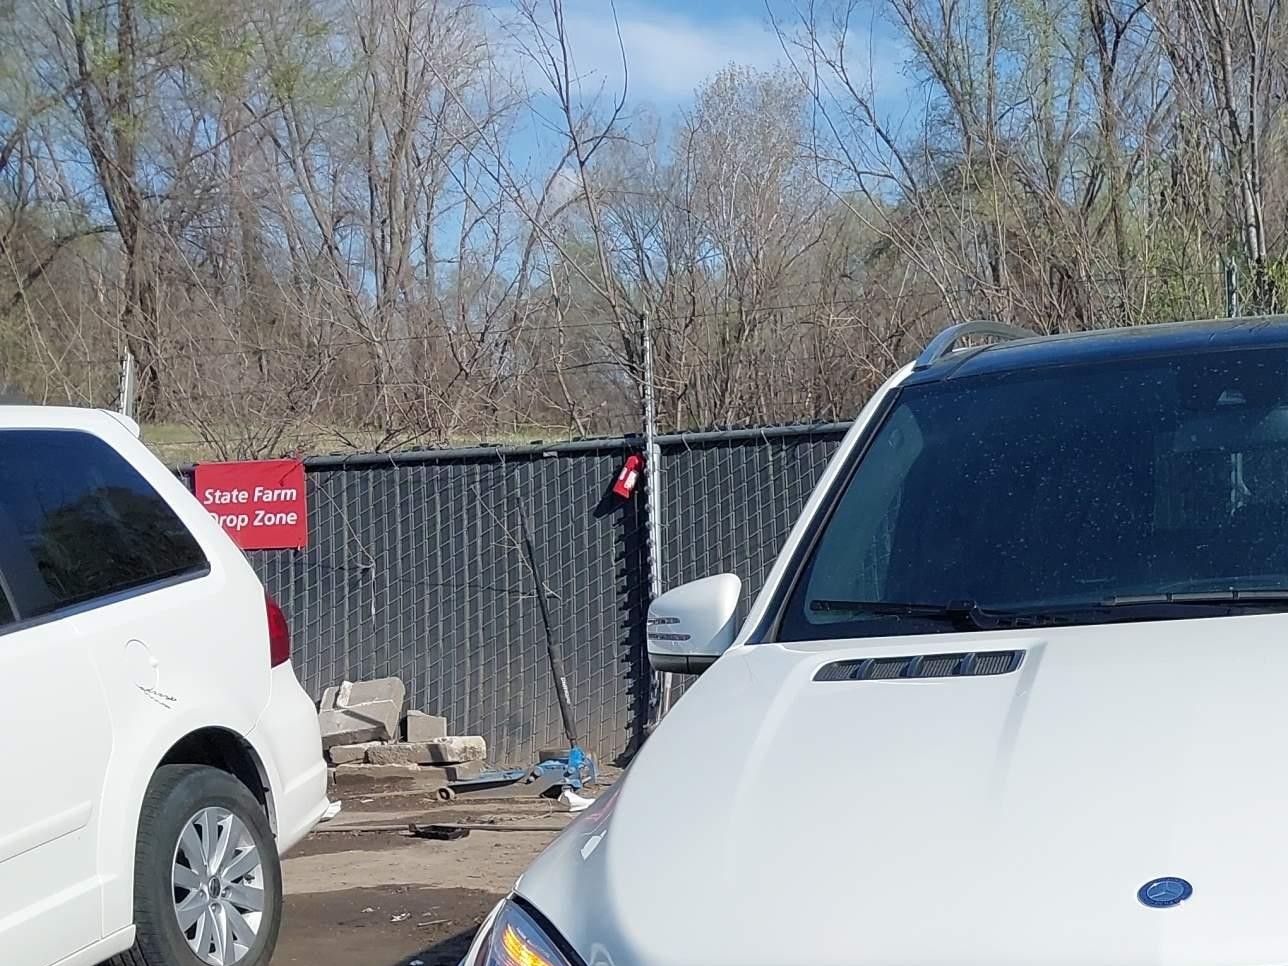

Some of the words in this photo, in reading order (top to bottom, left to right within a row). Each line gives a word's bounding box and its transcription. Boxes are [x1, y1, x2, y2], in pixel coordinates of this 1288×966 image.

[204, 488, 249, 504] State
[253, 486, 297, 502] Farm
[253, 510, 298, 526] Zone
